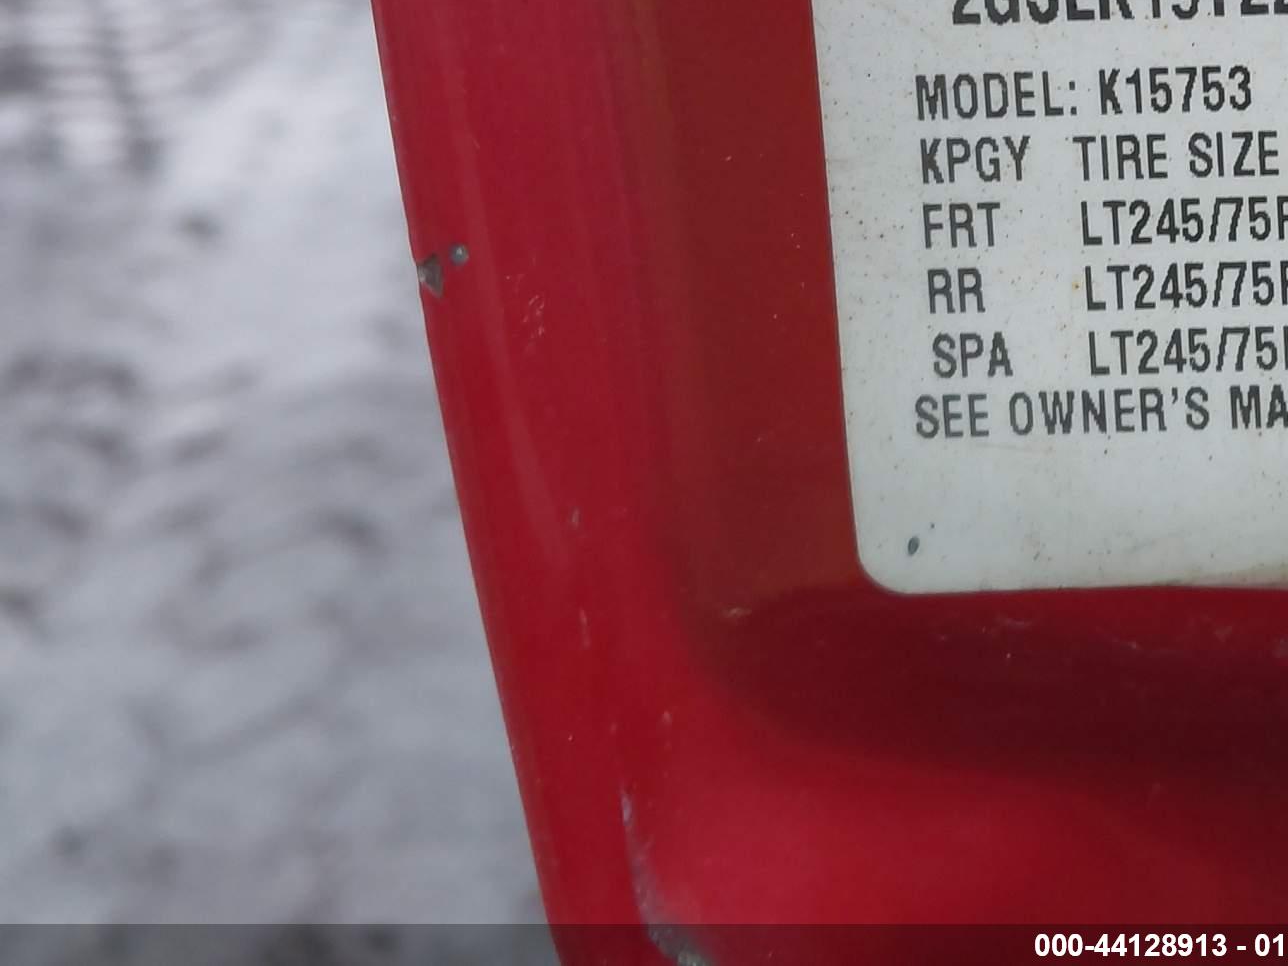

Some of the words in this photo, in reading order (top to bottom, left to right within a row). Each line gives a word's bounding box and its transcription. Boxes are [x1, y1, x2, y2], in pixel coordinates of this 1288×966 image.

[916, 71, 1078, 121] MODEL:
[1099, 65, 1252, 116] K15753
[920, 135, 1031, 184] KPGY
[1073, 133, 1168, 182] TIRE
[1189, 130, 1280, 178] SIZE
[923, 202, 1001, 249] FRT
[927, 267, 986, 314] RR
[932, 331, 1014, 379] SPA
[915, 393, 990, 439] SEE
[1009, 386, 1211, 436] OWNER'S
